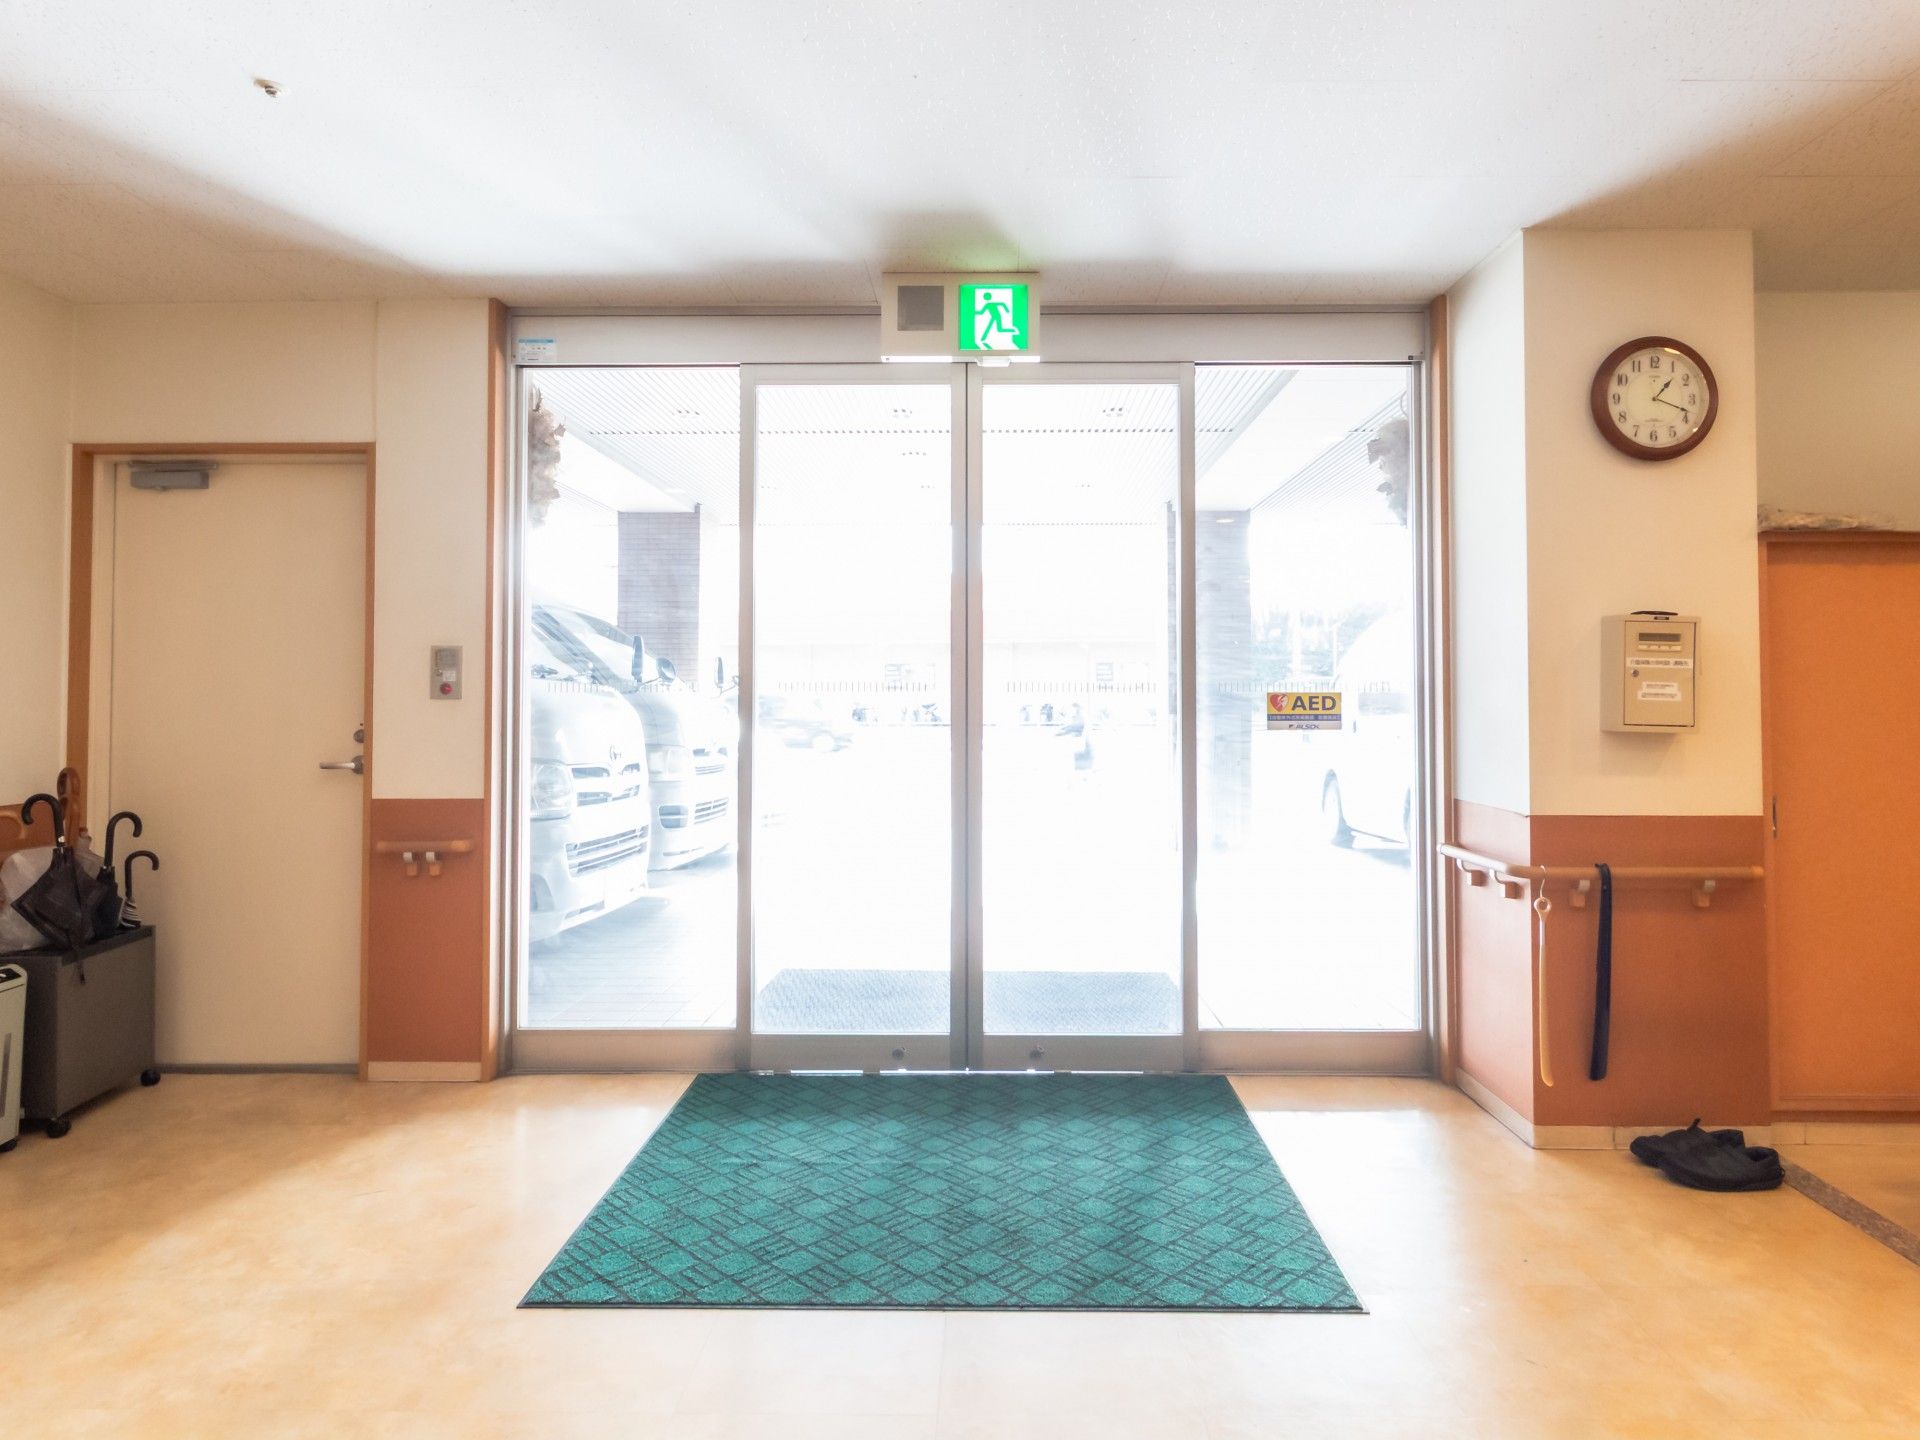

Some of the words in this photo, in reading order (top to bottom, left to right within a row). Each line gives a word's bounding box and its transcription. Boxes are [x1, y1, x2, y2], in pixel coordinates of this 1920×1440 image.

[1632, 360, 1641, 372] 11
[1650, 356, 1660, 368] 12
[1671, 361, 1674, 373] 1
[1617, 374, 1628, 386] 10
[1682, 374, 1689, 386] 2
[1612, 393, 1620, 405] 9
[1689, 394, 1696, 405] 3
[1619, 411, 1627, 423] 8
[1682, 412, 1688, 424] 4
[1633, 425, 1640, 437] 7
[1650, 430, 1658, 441] 6
[1669, 426, 1676, 438] 5
[1292, 696, 1336, 710] AED
